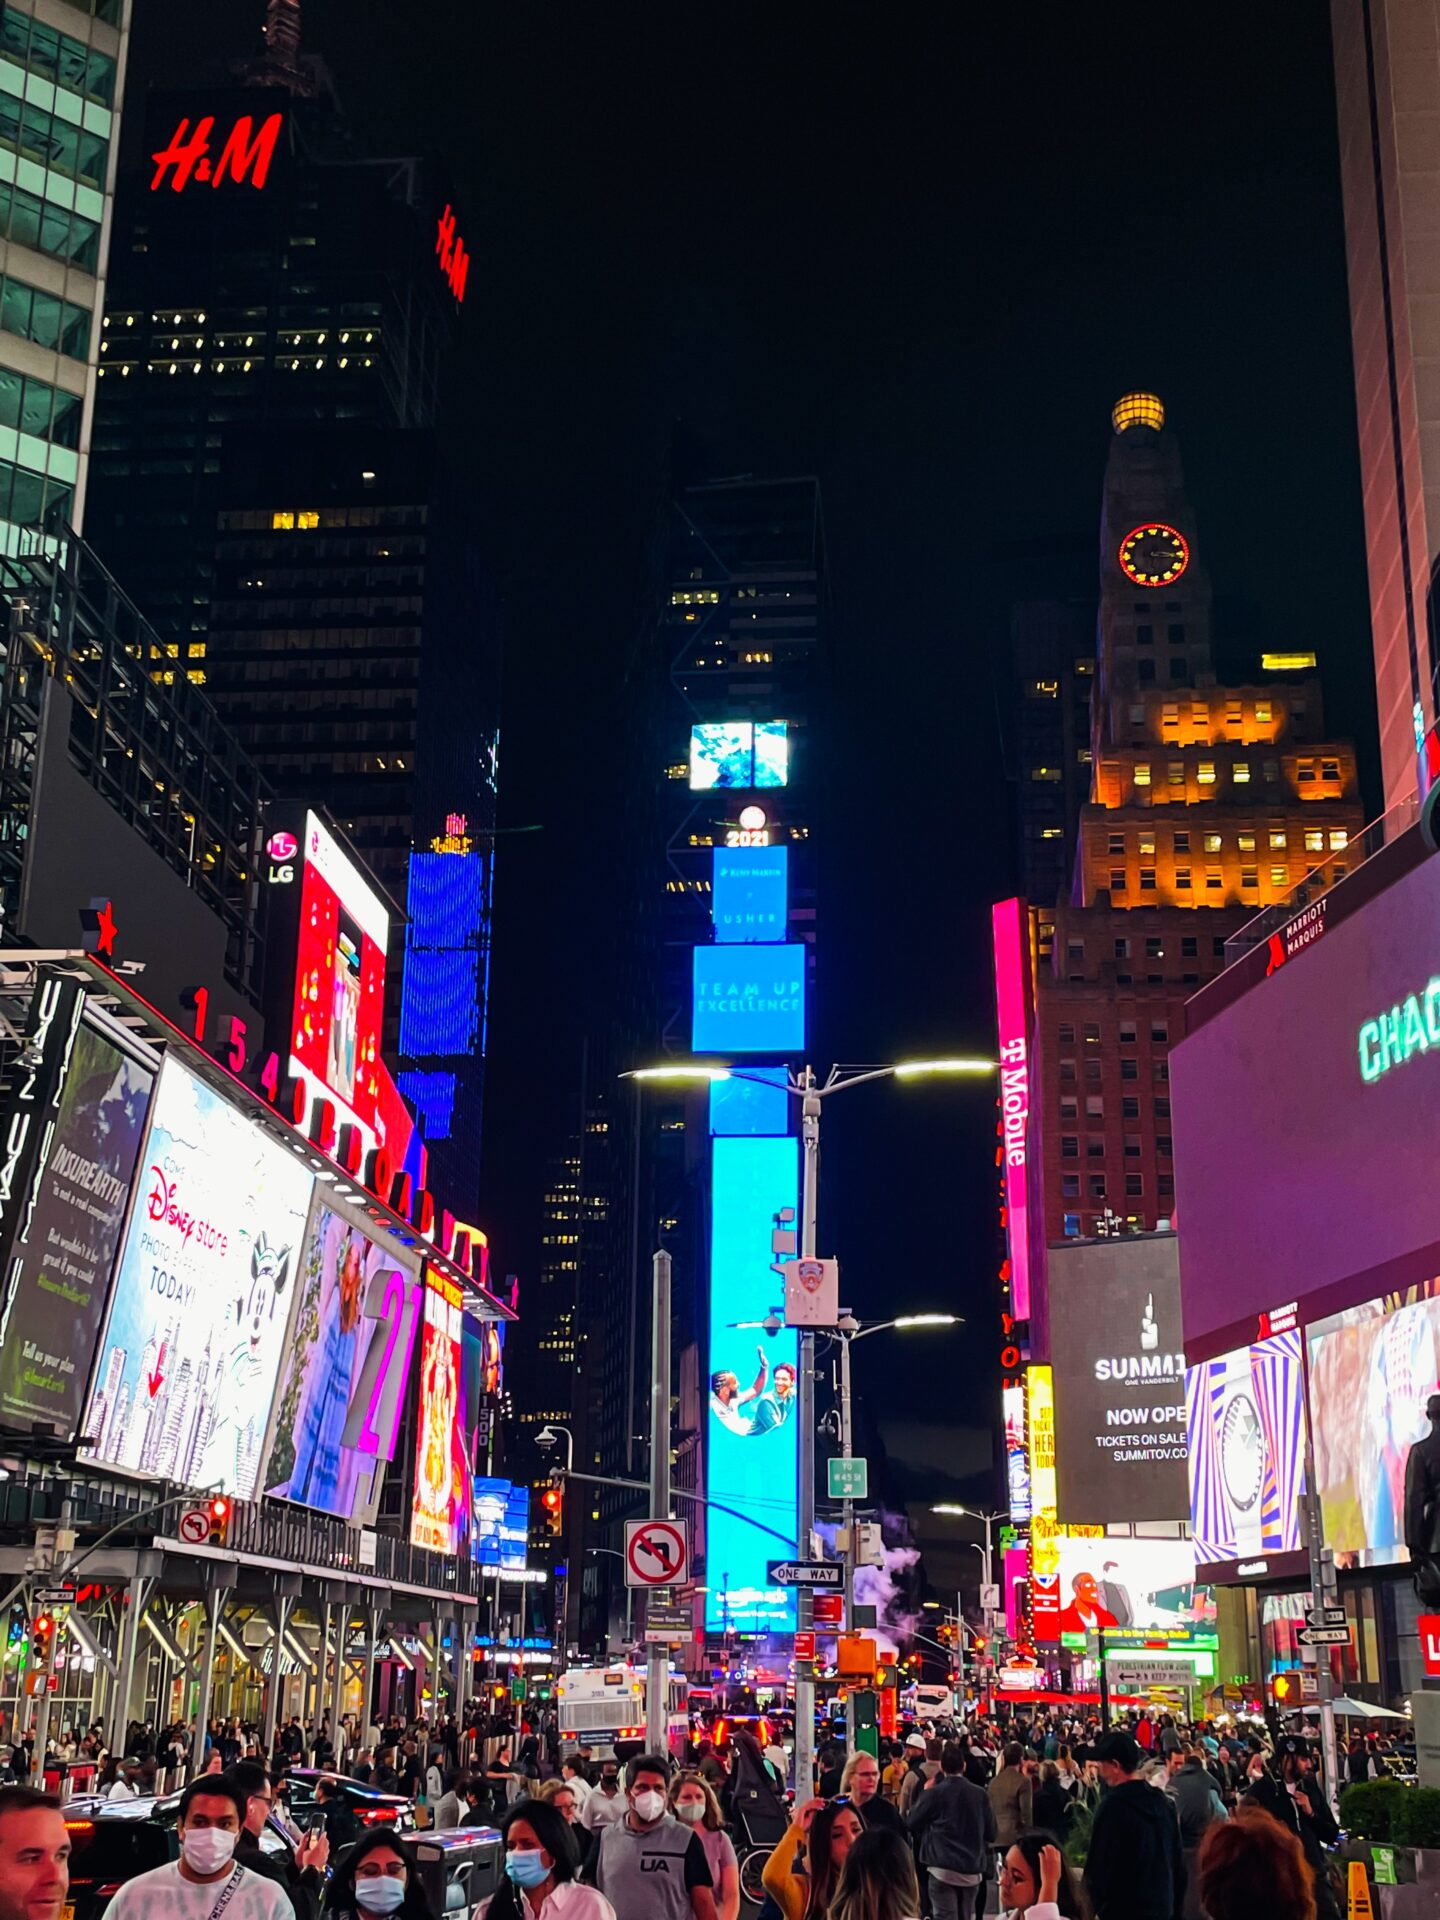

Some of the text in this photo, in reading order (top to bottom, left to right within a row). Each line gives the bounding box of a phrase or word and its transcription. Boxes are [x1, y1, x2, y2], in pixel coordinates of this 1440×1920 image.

[150, 113, 283, 192] H&M
[436, 204, 470, 302] H&M
[727, 831, 769, 848] 2021
[269, 865, 294, 884] LG
[724, 914, 775, 924] USHER
[1286, 899, 1327, 939] MARRIOTT
[1287, 919, 1325, 956] MARQUIS
[700, 982, 800, 996] TEAM UP
[698, 999, 799, 1013] EXCELLENCE
[194, 986, 306, 1126] 1540
[197, 1220, 227, 1257] store
[77, 1269, 96, 1285] could
[150, 1265, 197, 1309] TODAY!
[22, 1340, 37, 1360] Tell
[42, 1353, 61, 1368] your
[58, 1355, 76, 1374] plan
[350, 1270, 423, 1462] 21
[1124, 1377, 1180, 1387] ONE VANDERBILT
[478, 1394, 490, 1447] 1500
[1106, 1407, 1150, 1426] NOW
[1095, 1432, 1187, 1447] TICKETS ON SALE
[1113, 1447, 1188, 1462] SUMMITOV.CO
[778, 1568, 833, 1580] ONE WAY
[1327, 1612, 1341, 1620] WAY
[1304, 1631, 1344, 1640] ONE WAY
[640, 1859, 669, 1873] UA
